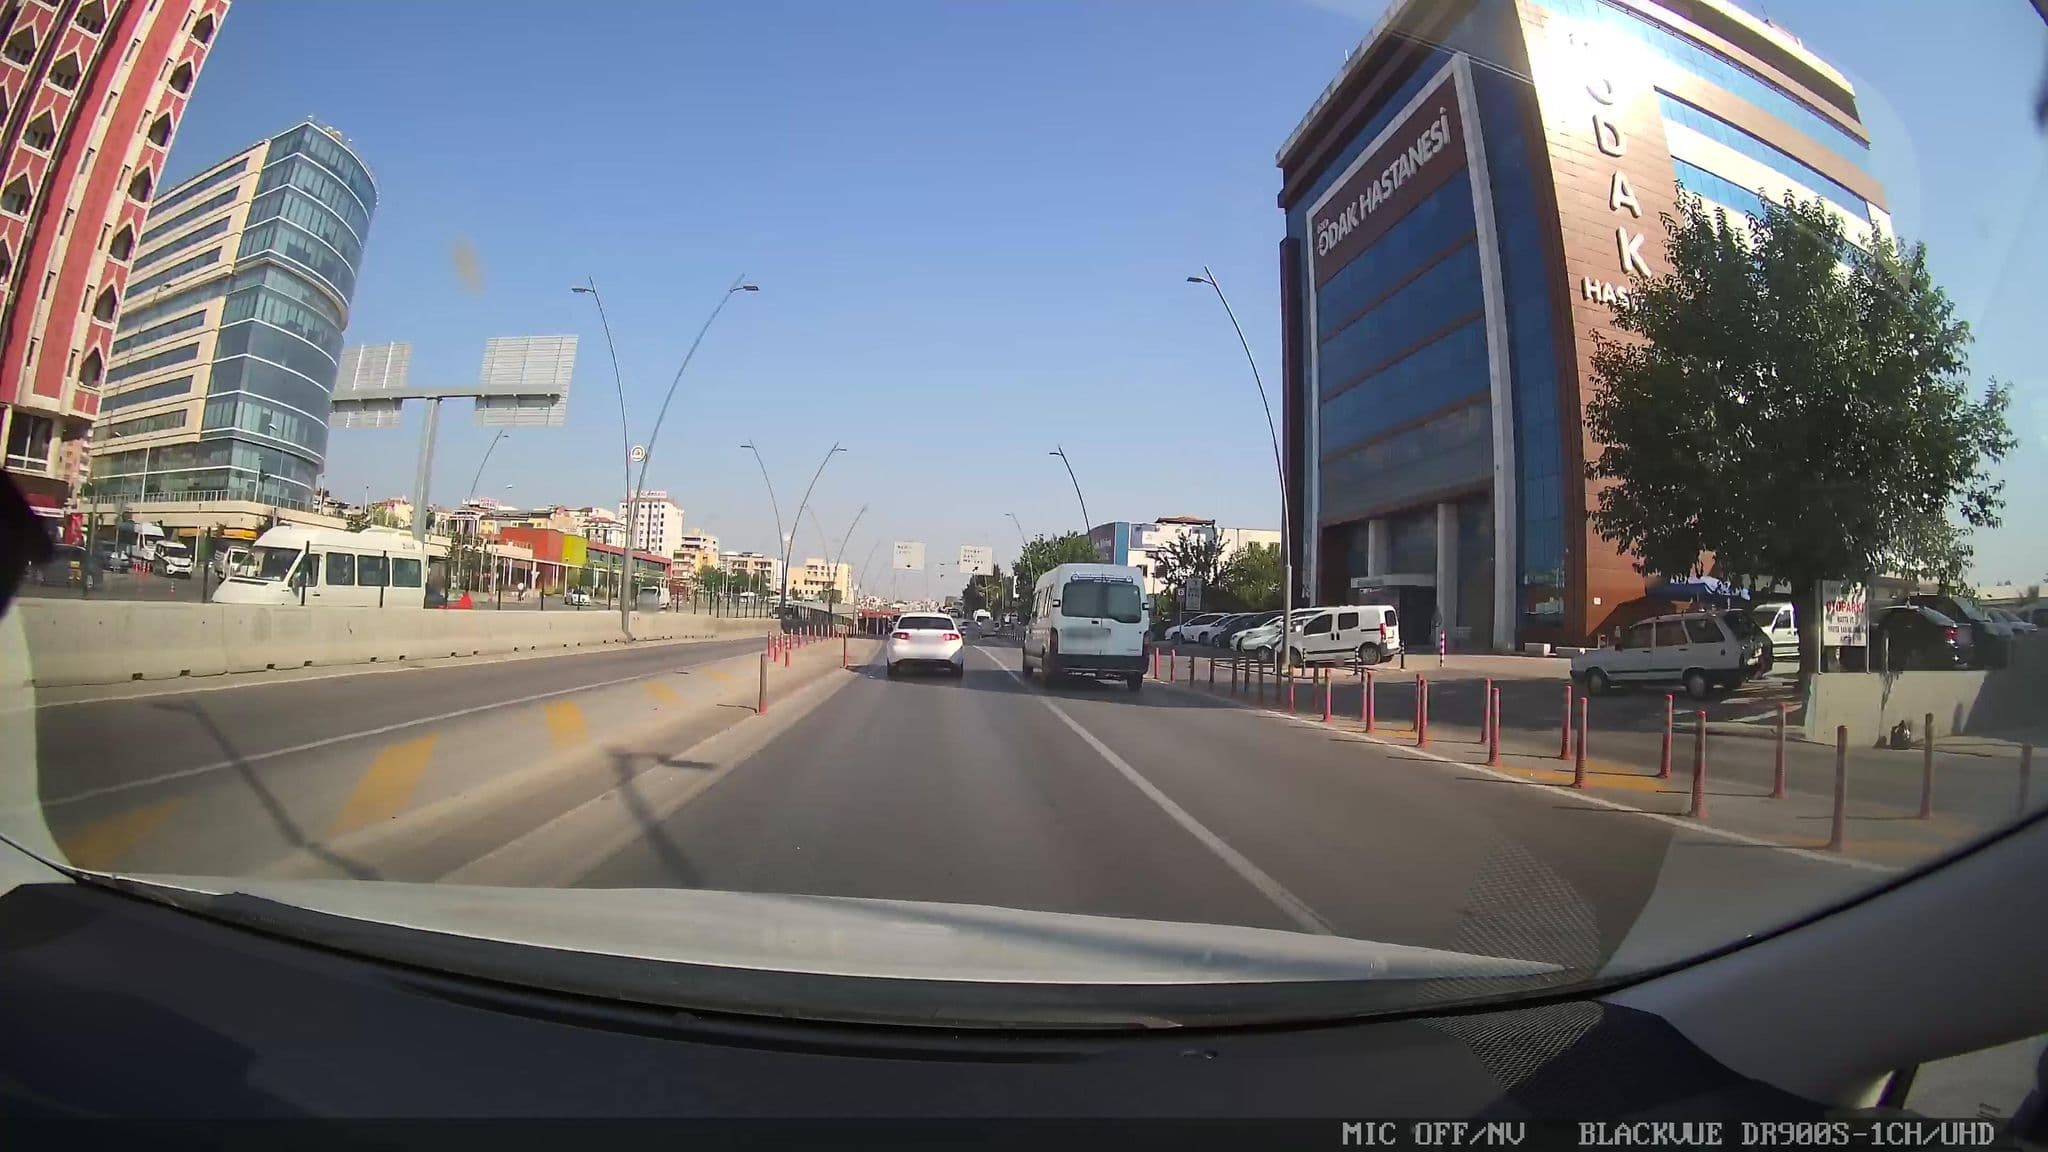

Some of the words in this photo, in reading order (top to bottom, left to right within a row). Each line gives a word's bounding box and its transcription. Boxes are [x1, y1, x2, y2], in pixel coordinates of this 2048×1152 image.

[1317, 202, 1359, 256] ODAK
[1360, 106, 1451, 221] HASTANESİ
[1585, 76, 1652, 278] ODAK
